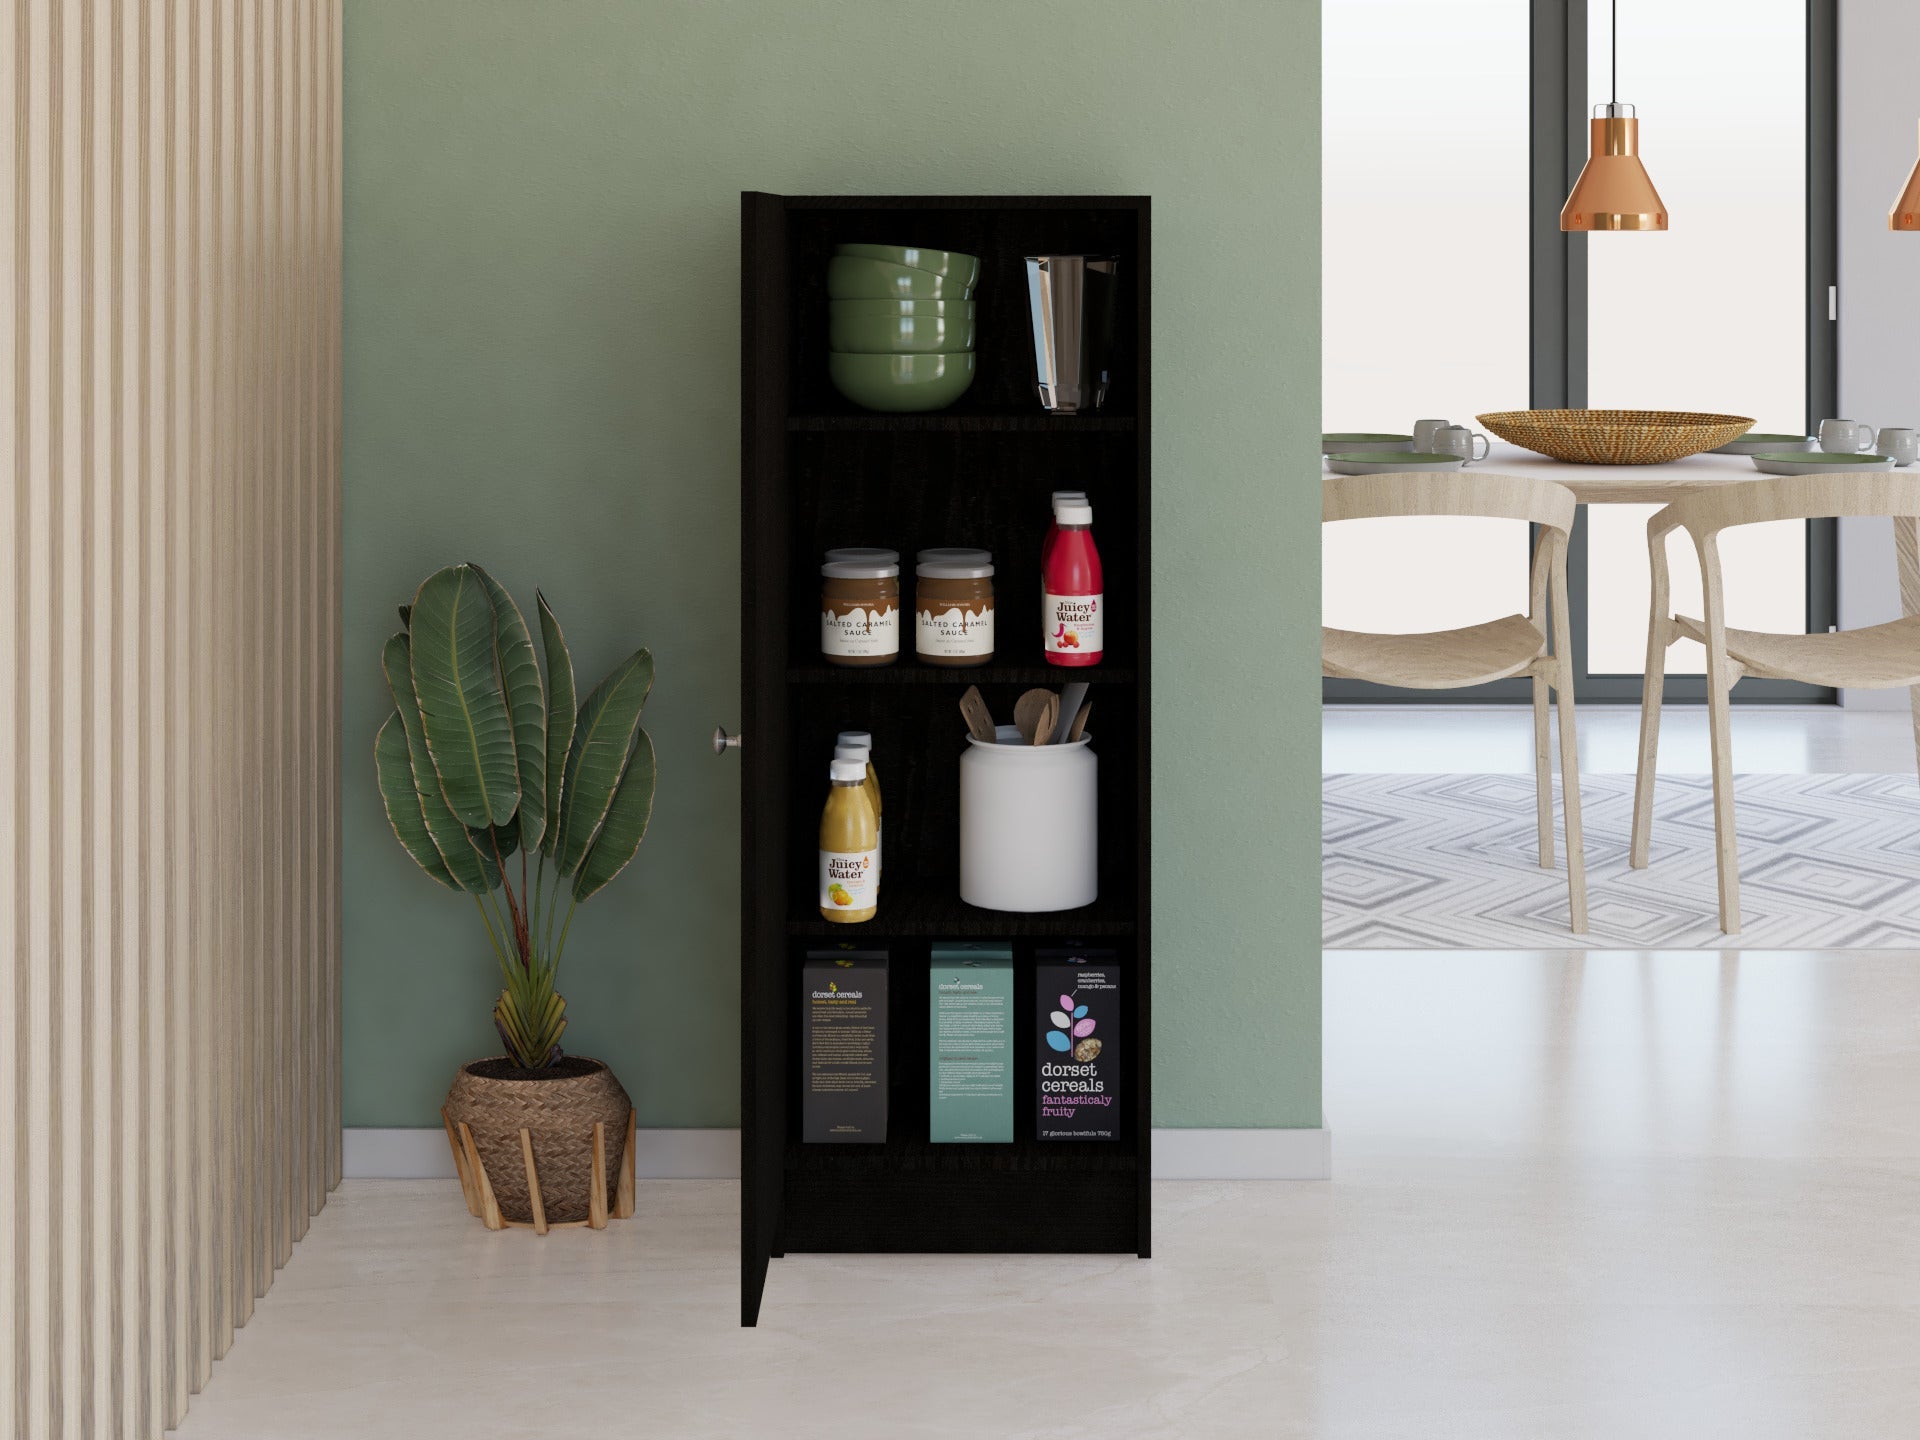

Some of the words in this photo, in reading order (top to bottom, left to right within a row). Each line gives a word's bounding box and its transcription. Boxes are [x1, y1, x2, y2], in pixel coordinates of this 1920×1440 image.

[1057, 601, 1090, 614] Juicy
[1056, 611, 1091, 622] Water
[829, 858, 862, 871] Juicy
[828, 868, 864, 879] Water
[811, 990, 836, 999] dorset
[836, 990, 863, 999] cereals
[1041, 1062, 1098, 1077] dorset
[1041, 1078, 1104, 1093] cereals
[1042, 1094, 1113, 1107] fantasticaly
[1042, 1106, 1076, 1119] fruity
